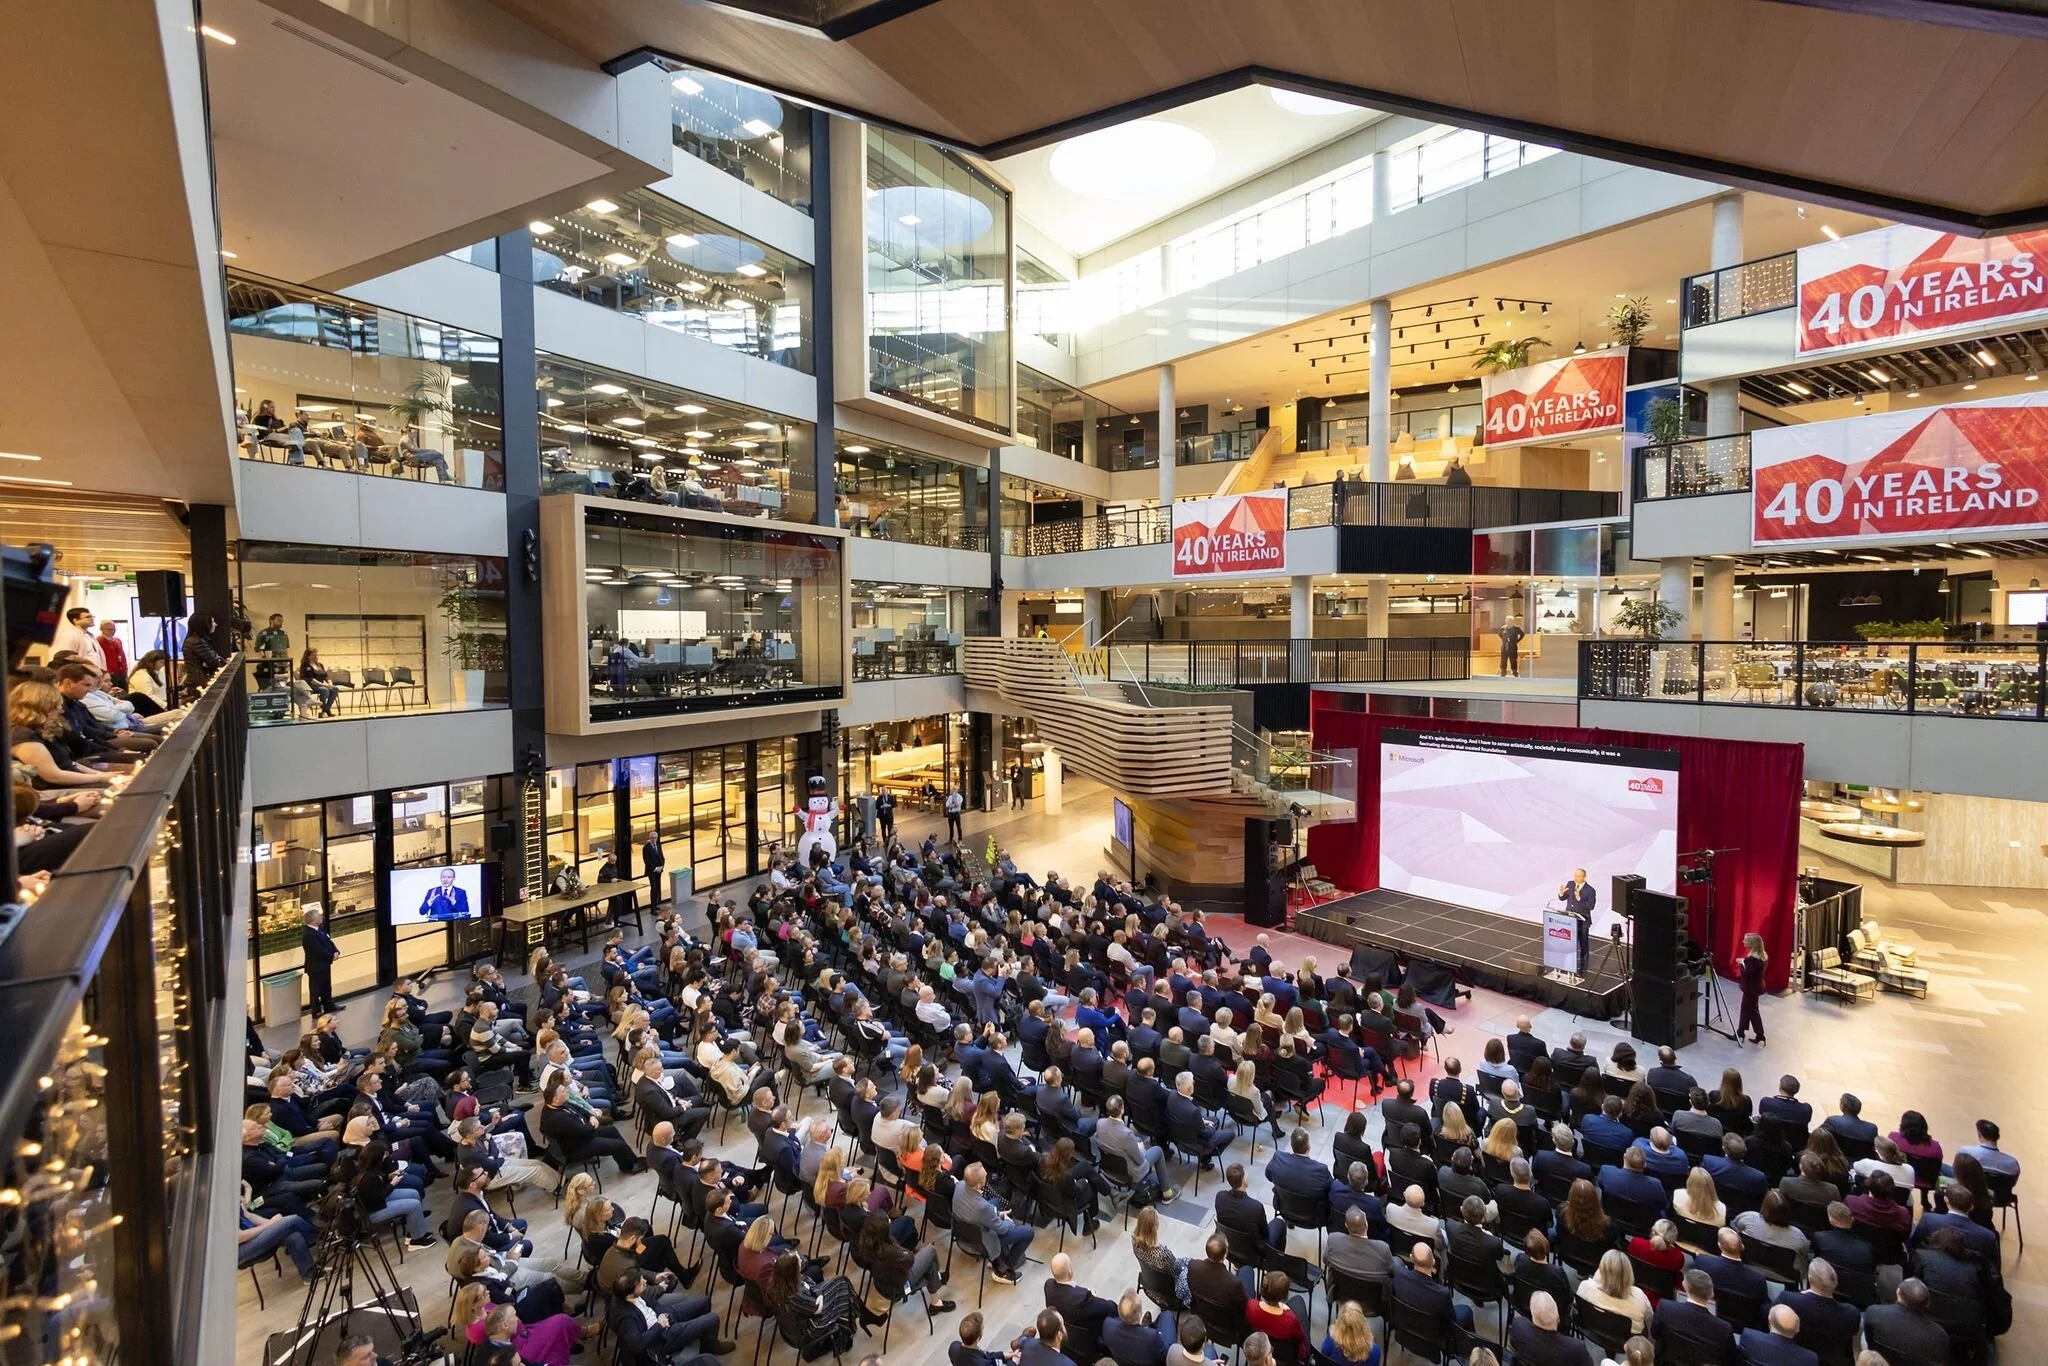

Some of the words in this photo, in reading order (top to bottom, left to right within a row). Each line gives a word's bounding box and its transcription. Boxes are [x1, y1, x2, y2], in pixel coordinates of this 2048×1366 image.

[1808, 284, 1886, 335] 40
[1894, 252, 2036, 302] YEARS
[1894, 300, 1924, 321] IN
[1935, 279, 2046, 314] IRELAN
[1486, 403, 1526, 435] 40
[1529, 389, 1601, 417] YEARS
[1529, 417, 1545, 429] IN
[1550, 404, 1617, 426] IRELAND
[1763, 478, 1844, 526] 40
[1853, 461, 2003, 500] YEARS
[1853, 501, 1883, 521] IN
[1895, 487, 2039, 517] IRELAND
[1176, 536, 1209, 566] 40
[1211, 530, 1266, 551] YEARS
[1211, 552, 1224, 564] IN
[1227, 546, 1280, 562] IRELAND
